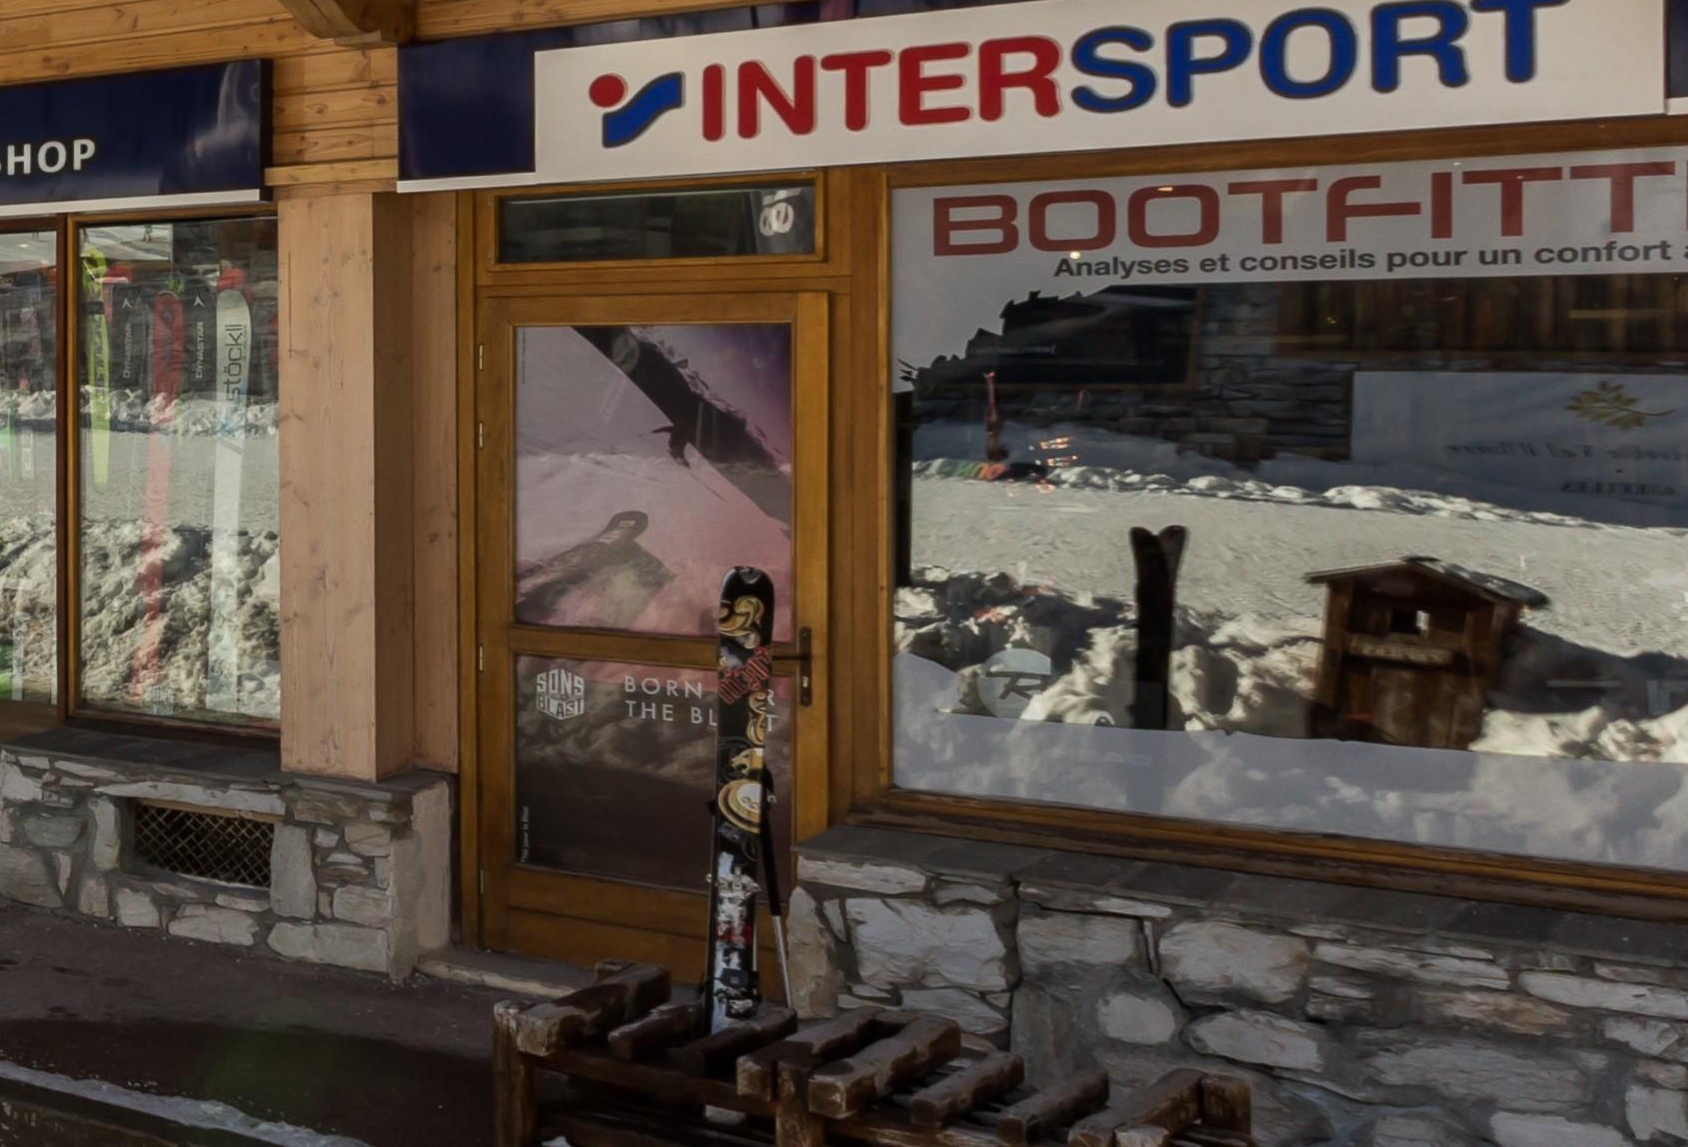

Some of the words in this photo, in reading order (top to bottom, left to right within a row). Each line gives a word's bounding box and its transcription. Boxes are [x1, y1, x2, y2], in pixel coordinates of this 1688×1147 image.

[933, 160, 1688, 256] BOOTFITT
[1054, 255, 1190, 280] Analyses
[1199, 253, 1230, 273] et
[1239, 248, 1376, 272] conseils
[1387, 249, 1467, 272] pour
[1479, 248, 1522, 265] un
[1534, 239, 1673, 265] confort
[195, 321, 205, 379] DYNASTAR
[223, 323, 244, 402] stöckli
[536, 668, 584, 696] SONS
[625, 676, 702, 699] BORN
[625, 701, 673, 721] THE
